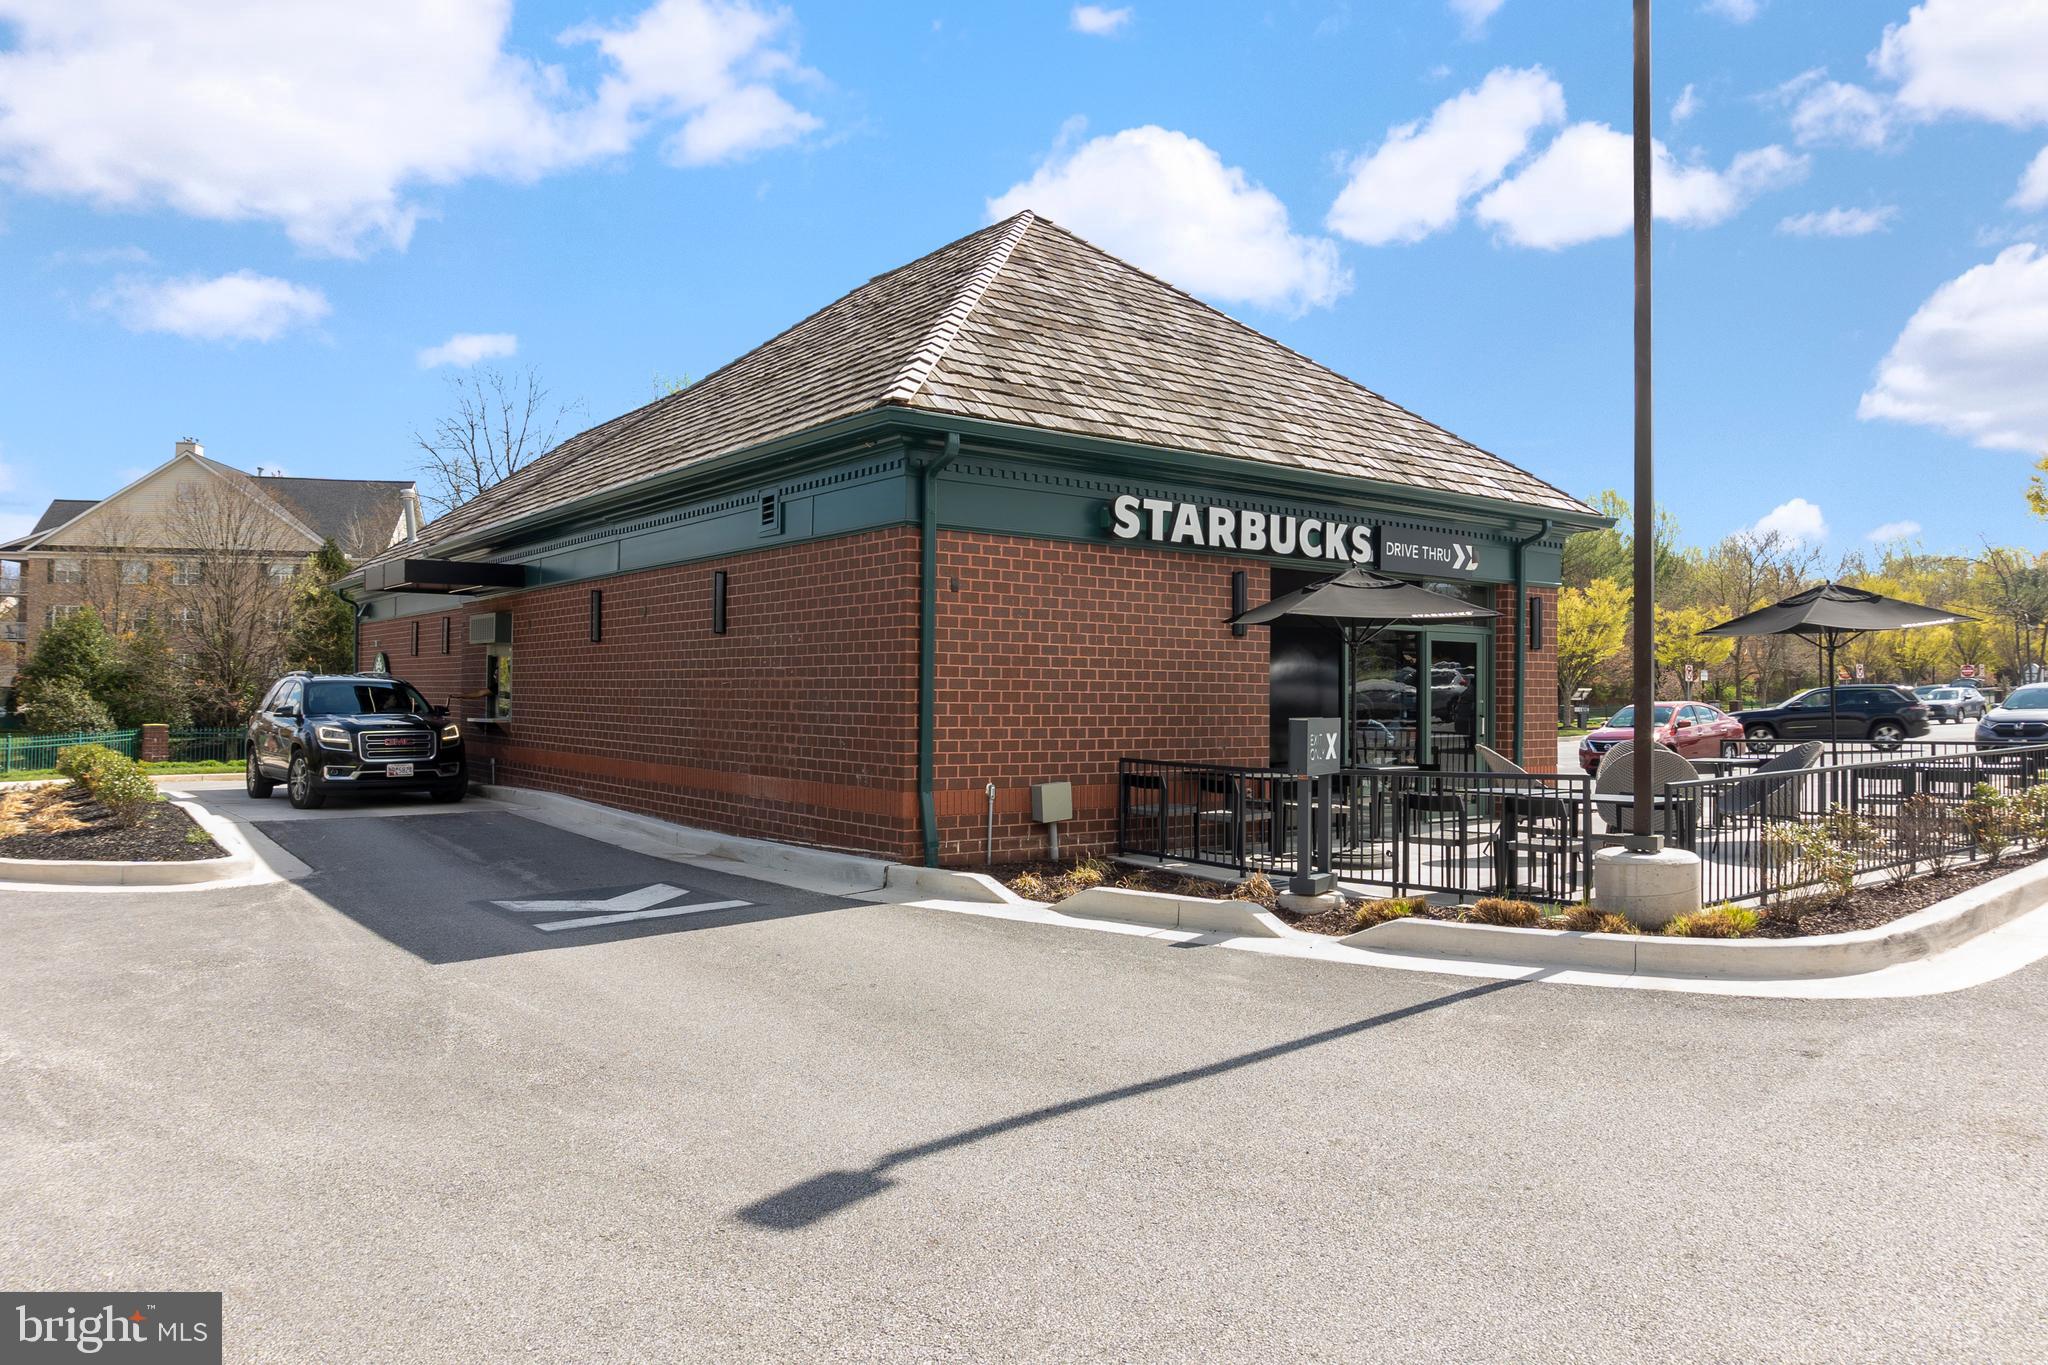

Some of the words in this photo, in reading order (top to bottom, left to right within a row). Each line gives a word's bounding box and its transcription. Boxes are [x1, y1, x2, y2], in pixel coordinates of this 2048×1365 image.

[1112, 494, 1372, 564] STARBUCKS
[1386, 541, 1419, 559] DRIVE
[1422, 545, 1451, 562] THRU
